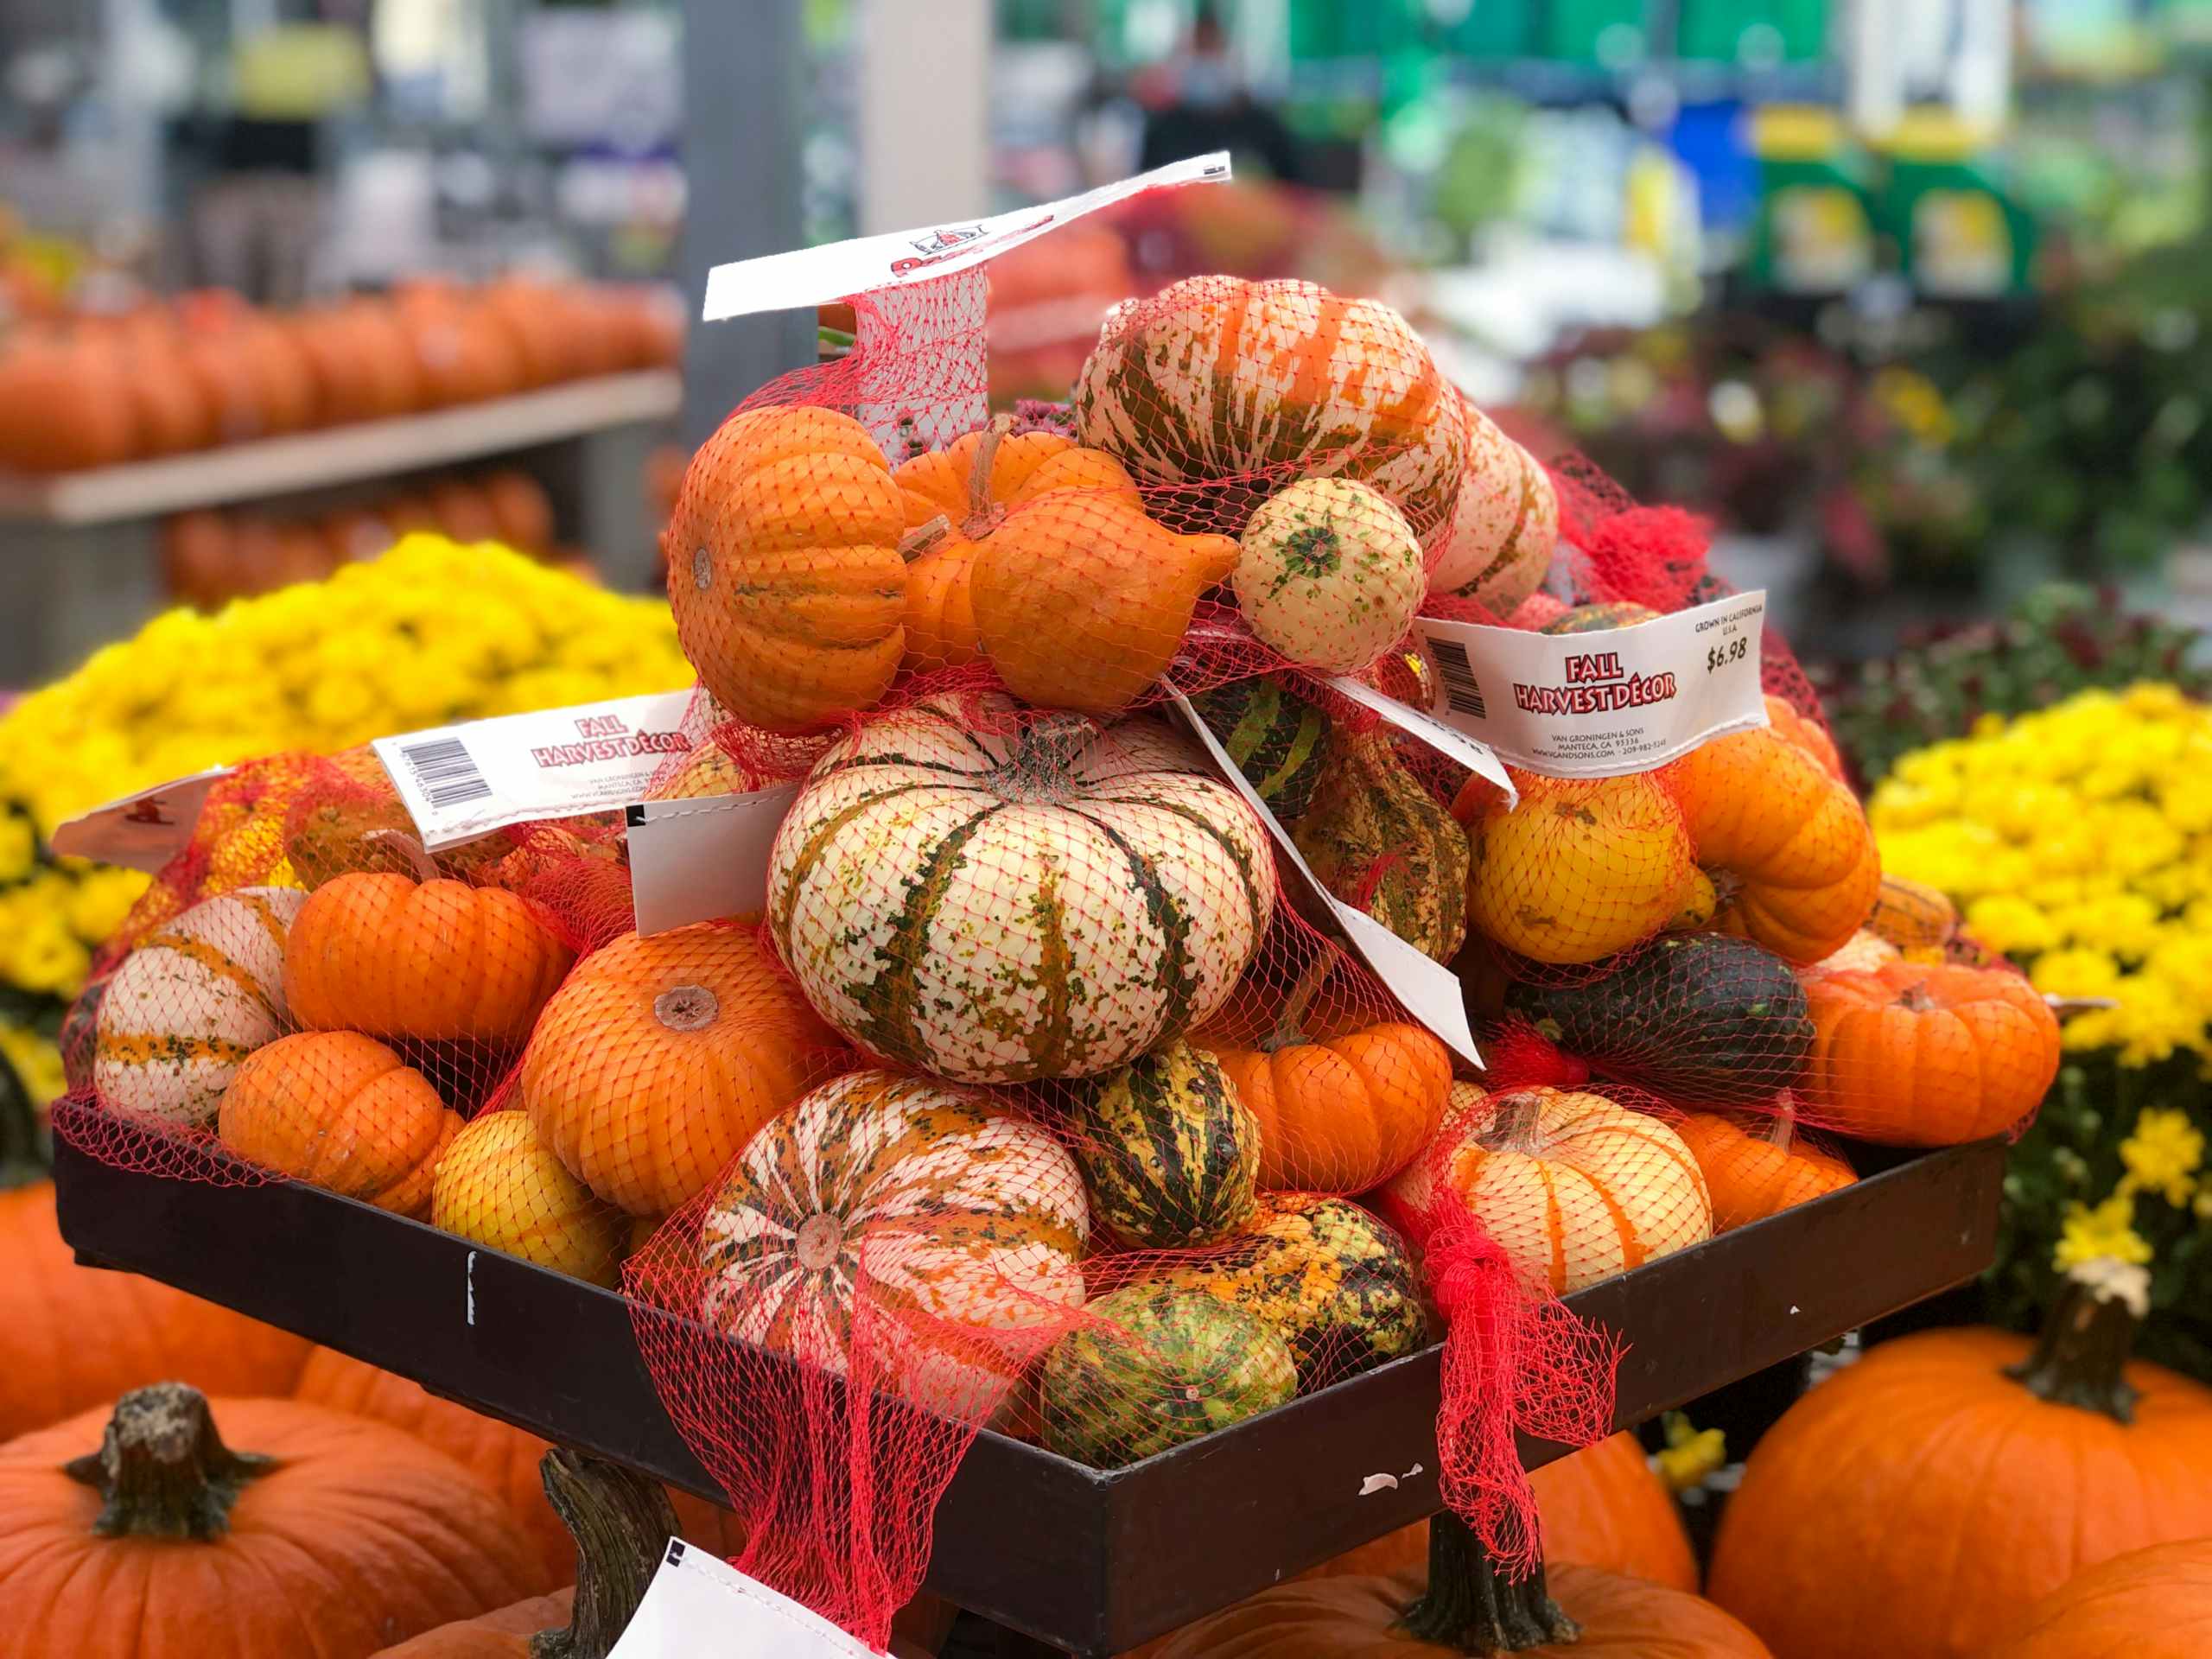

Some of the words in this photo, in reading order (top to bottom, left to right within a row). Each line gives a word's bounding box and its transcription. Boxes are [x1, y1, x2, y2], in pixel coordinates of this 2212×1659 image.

[1695, 617, 1720, 632] GROWN
[1720, 614, 1728, 626] IN
[1728, 604, 1763, 622] CALIFORNIA
[1565, 652, 1624, 683] FALL
[1707, 636, 1747, 675] $6.98
[1513, 683, 1609, 715] HARVEST
[1612, 672, 1677, 710] DÉCOR
[575, 714, 629, 739] FALL
[1552, 734, 1568, 743] VAN
[1569, 731, 1618, 743] GRONINGEN
[1618, 730, 1624, 739] &
[1625, 728, 1644, 738] SONS
[531, 736, 628, 768] HARVEST
[624, 728, 694, 756] DÉCOR
